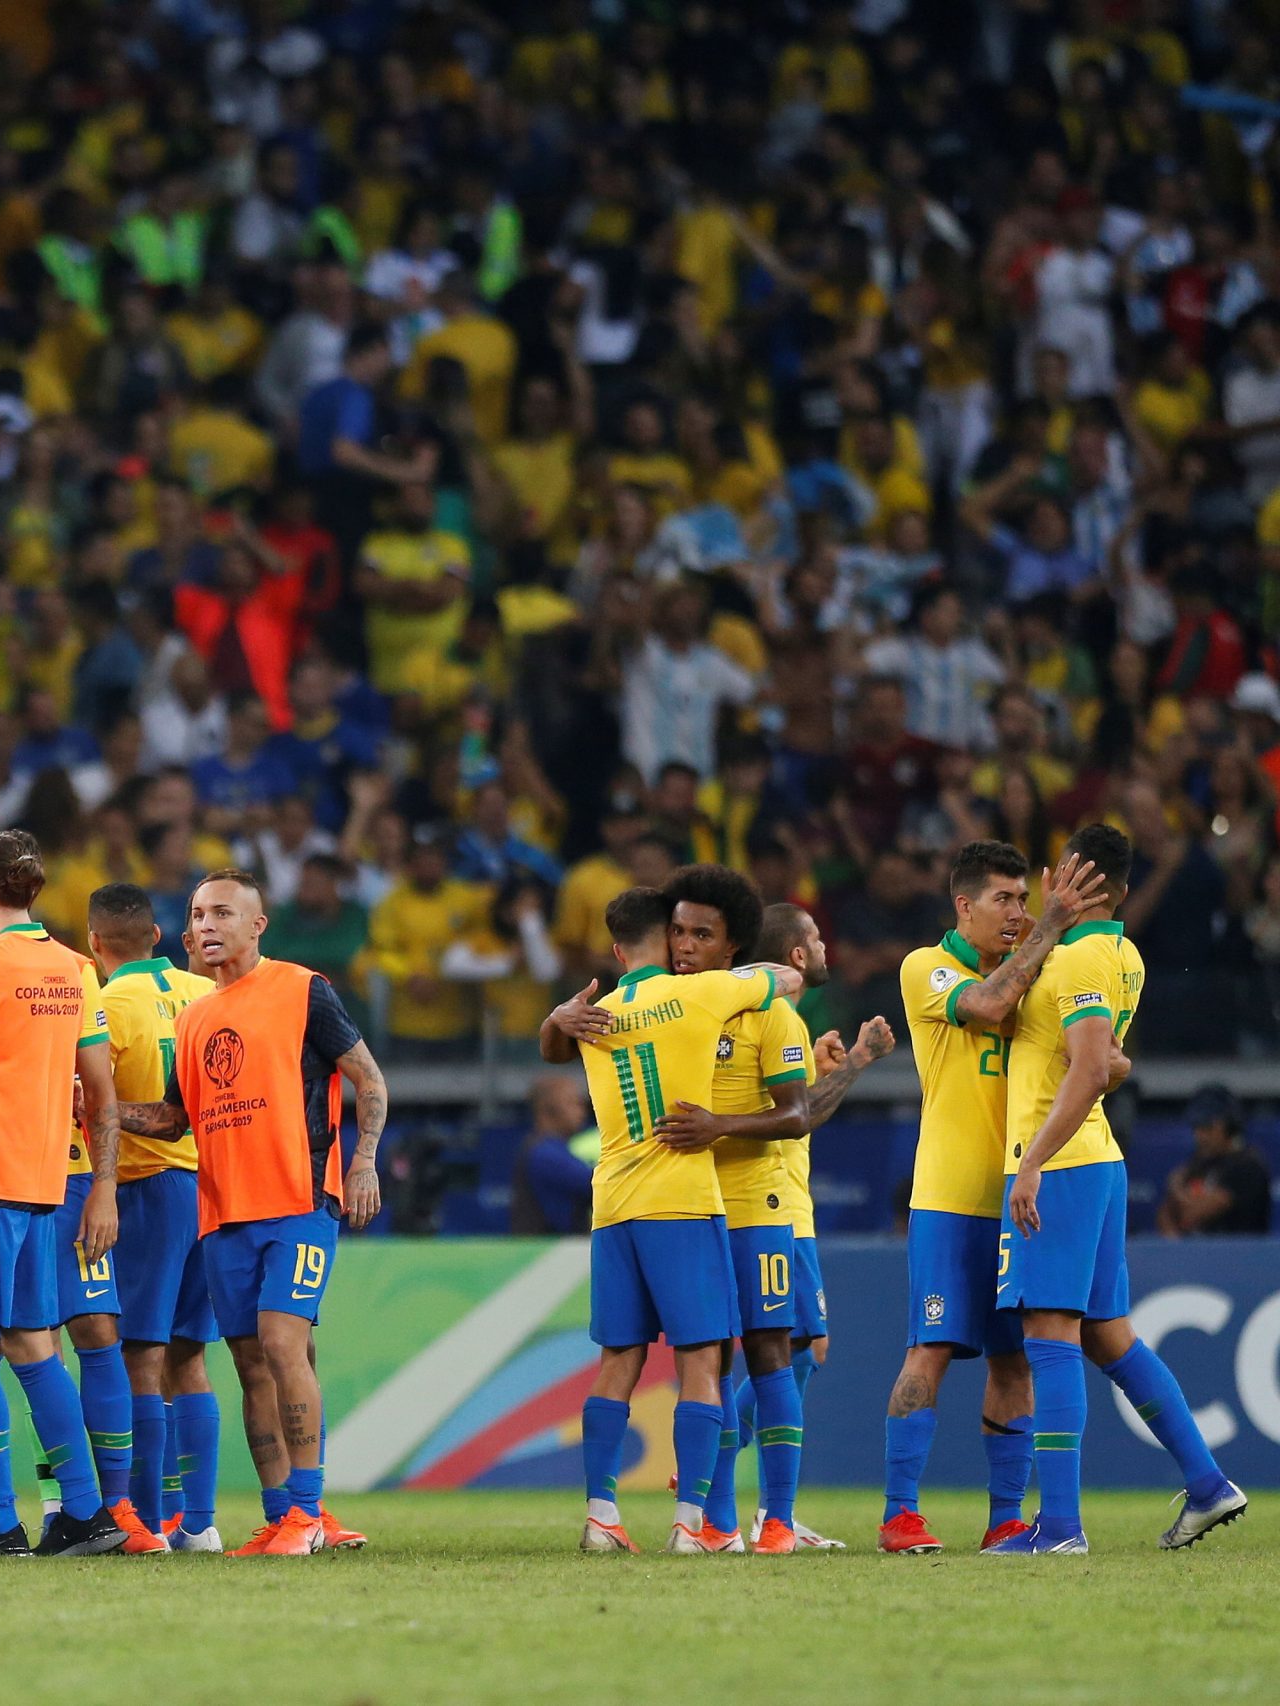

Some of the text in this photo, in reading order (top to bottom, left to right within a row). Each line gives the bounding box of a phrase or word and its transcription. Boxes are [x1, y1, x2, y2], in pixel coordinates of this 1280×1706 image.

[15, 987, 83, 999] COPA AMERIC
[62, 1003, 79, 1016] 2019
[601, 999, 683, 1035] OUTINHO
[217, 1098, 267, 1117] AMERICA
[611, 1041, 666, 1143] 11
[232, 1115, 252, 1127] 2019
[292, 1243, 326, 1289] 19
[998, 1232, 1012, 1276] 5
[758, 1253, 790, 1296] 10
